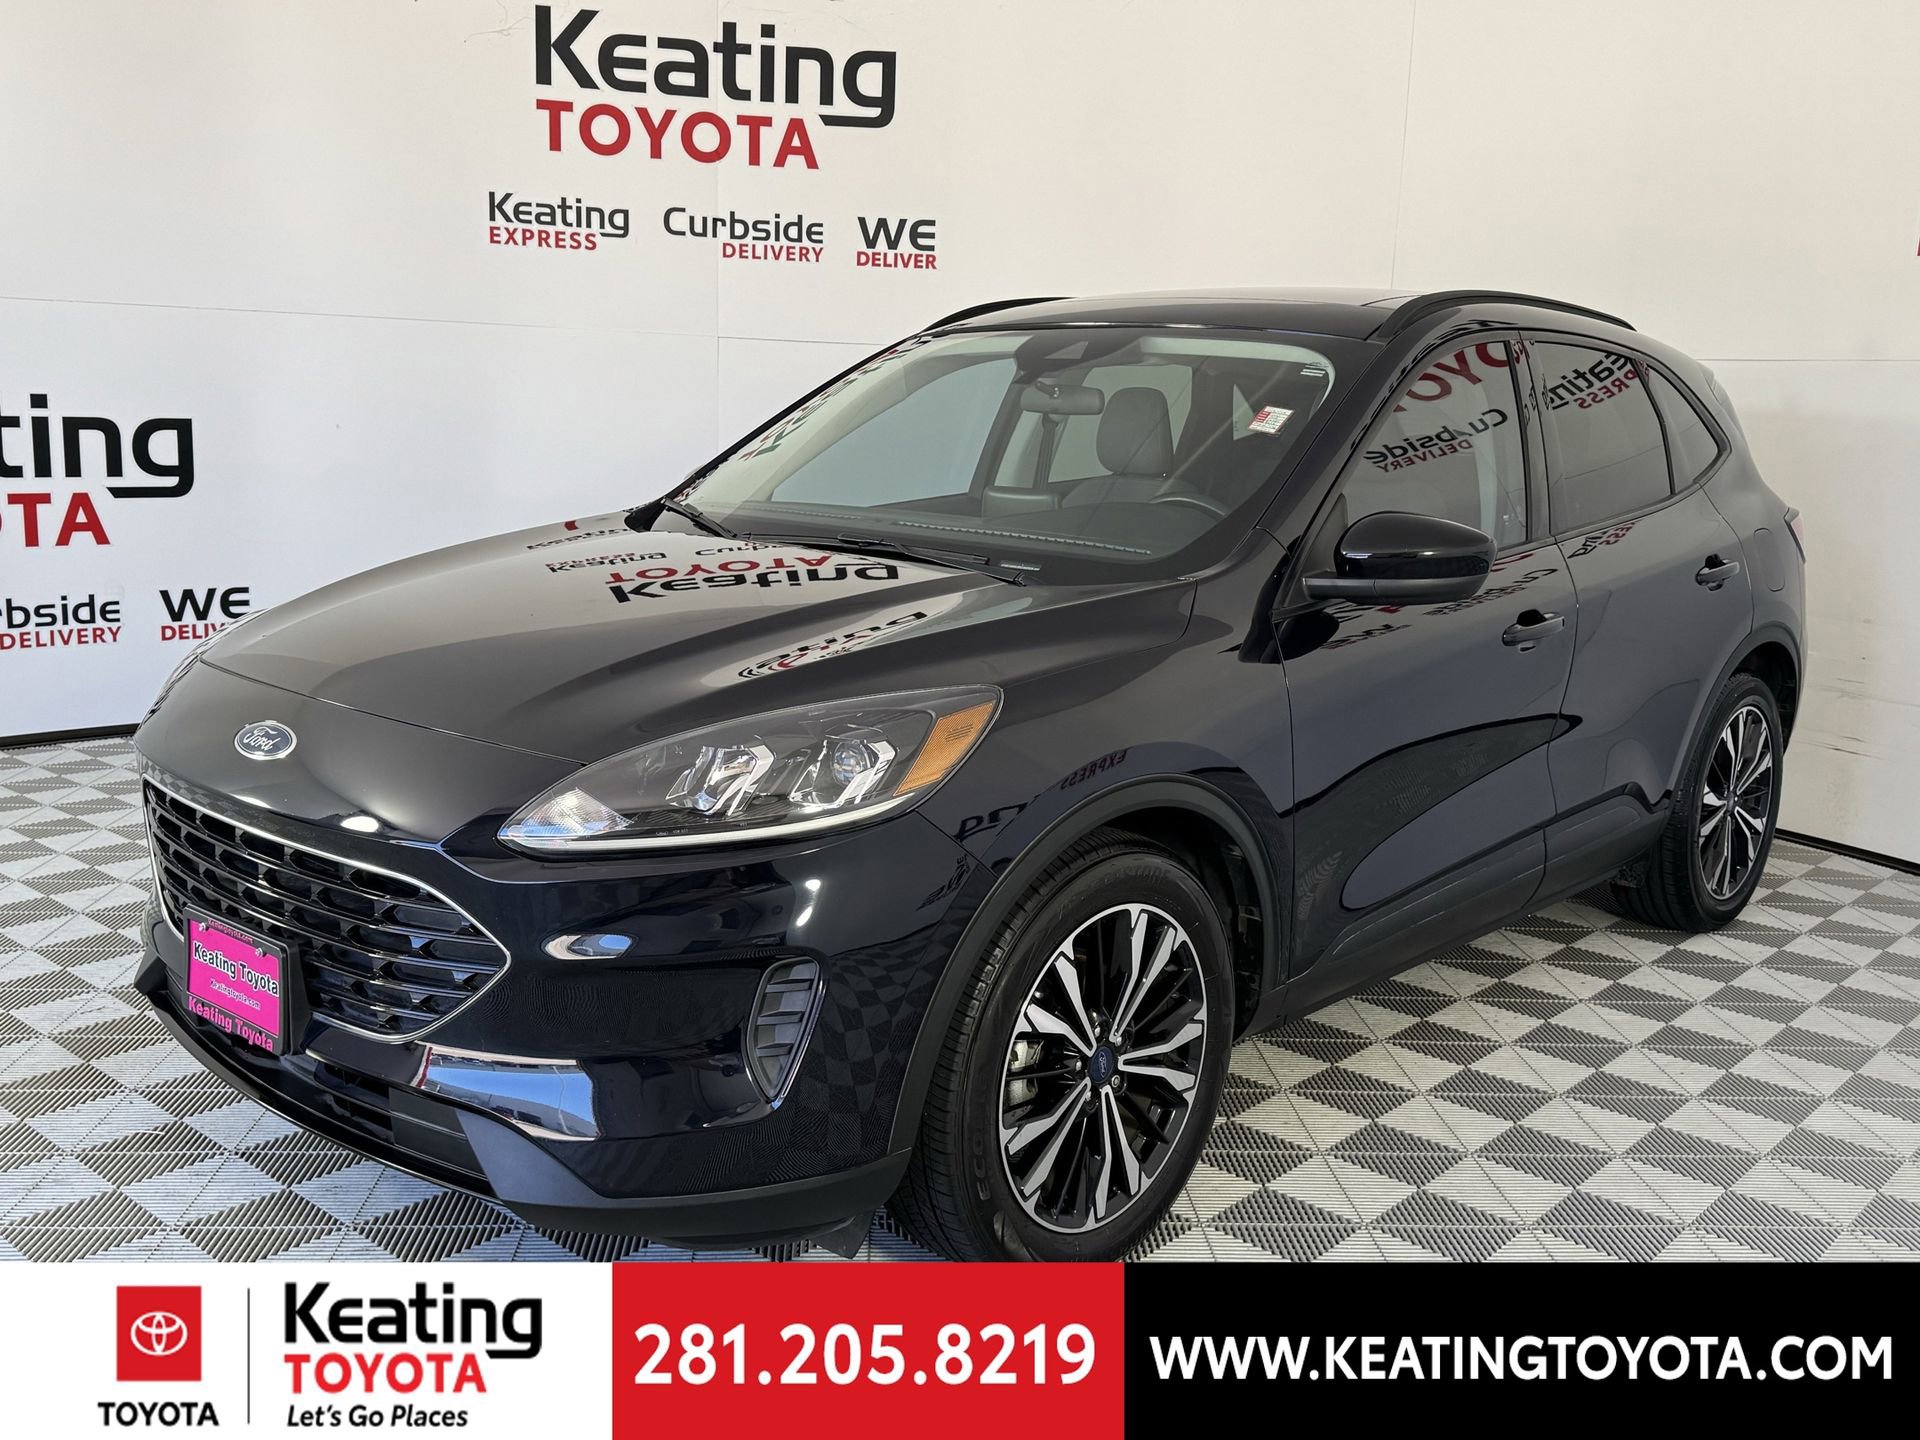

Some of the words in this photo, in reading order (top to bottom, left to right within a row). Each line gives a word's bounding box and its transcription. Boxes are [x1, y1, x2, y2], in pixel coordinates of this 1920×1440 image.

[535, 4, 897, 128] Keating
[536, 98, 819, 169] TOYOTA
[489, 191, 630, 238] Keating
[664, 206, 824, 244] Curbside
[489, 226, 598, 250] EXPRESS
[722, 242, 824, 262] DELIVERY
[856, 251, 937, 270] DELIVER
[0, 492, 111, 547] TA
[0, 594, 121, 629] bside
[1, 626, 122, 650] DELIVERY
[161, 622, 226, 641] DELIV
[193, 941, 238, 981] Keating
[239, 962, 280, 997] Toyota
[188, 996, 233, 1034] Keating
[235, 1019, 274, 1052] Toyota
